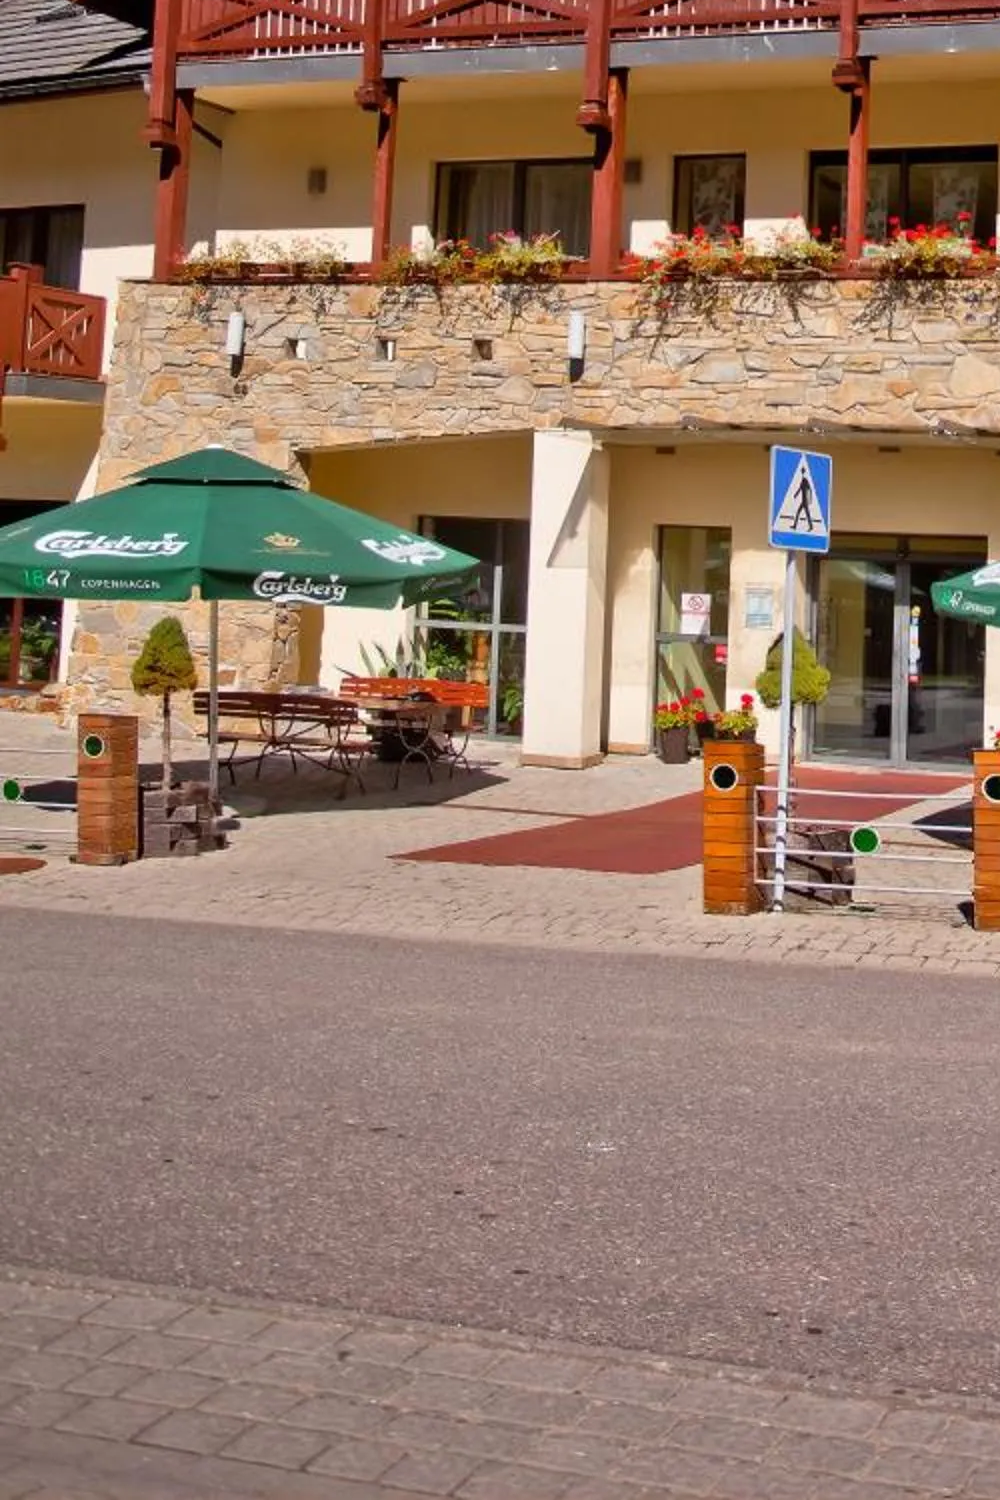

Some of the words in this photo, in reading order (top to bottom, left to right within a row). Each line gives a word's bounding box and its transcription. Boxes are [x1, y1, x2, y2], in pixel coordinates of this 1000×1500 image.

[34, 530, 190, 558] Carlsberg
[24, 569, 71, 589] 1847
[80, 579, 161, 589] COPENHAGEN
[253, 570, 347, 605] Carlsberg
